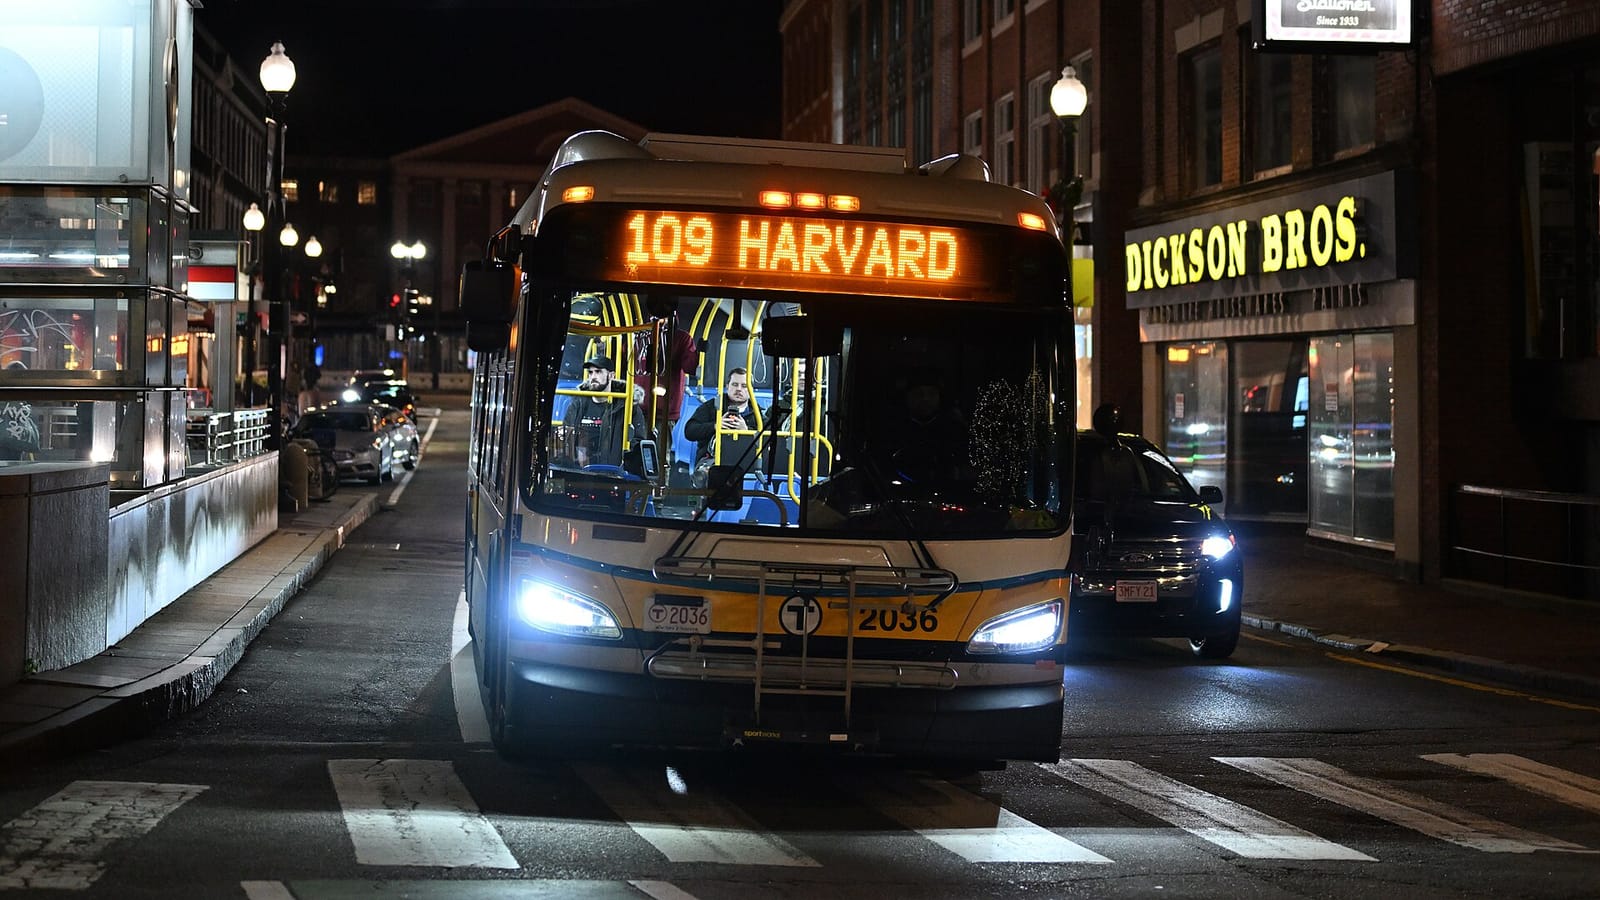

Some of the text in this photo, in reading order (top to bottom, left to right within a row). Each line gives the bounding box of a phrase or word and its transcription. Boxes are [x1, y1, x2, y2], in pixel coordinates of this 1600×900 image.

[1316, 15, 1359, 26] Since 1933
[627, 213, 958, 280] 109 HARVARD
[1126, 196, 1365, 292] DICKSON BROS.
[1143, 585, 1155, 598] 21
[670, 606, 708, 626] 2036
[858, 607, 938, 633] 2036
